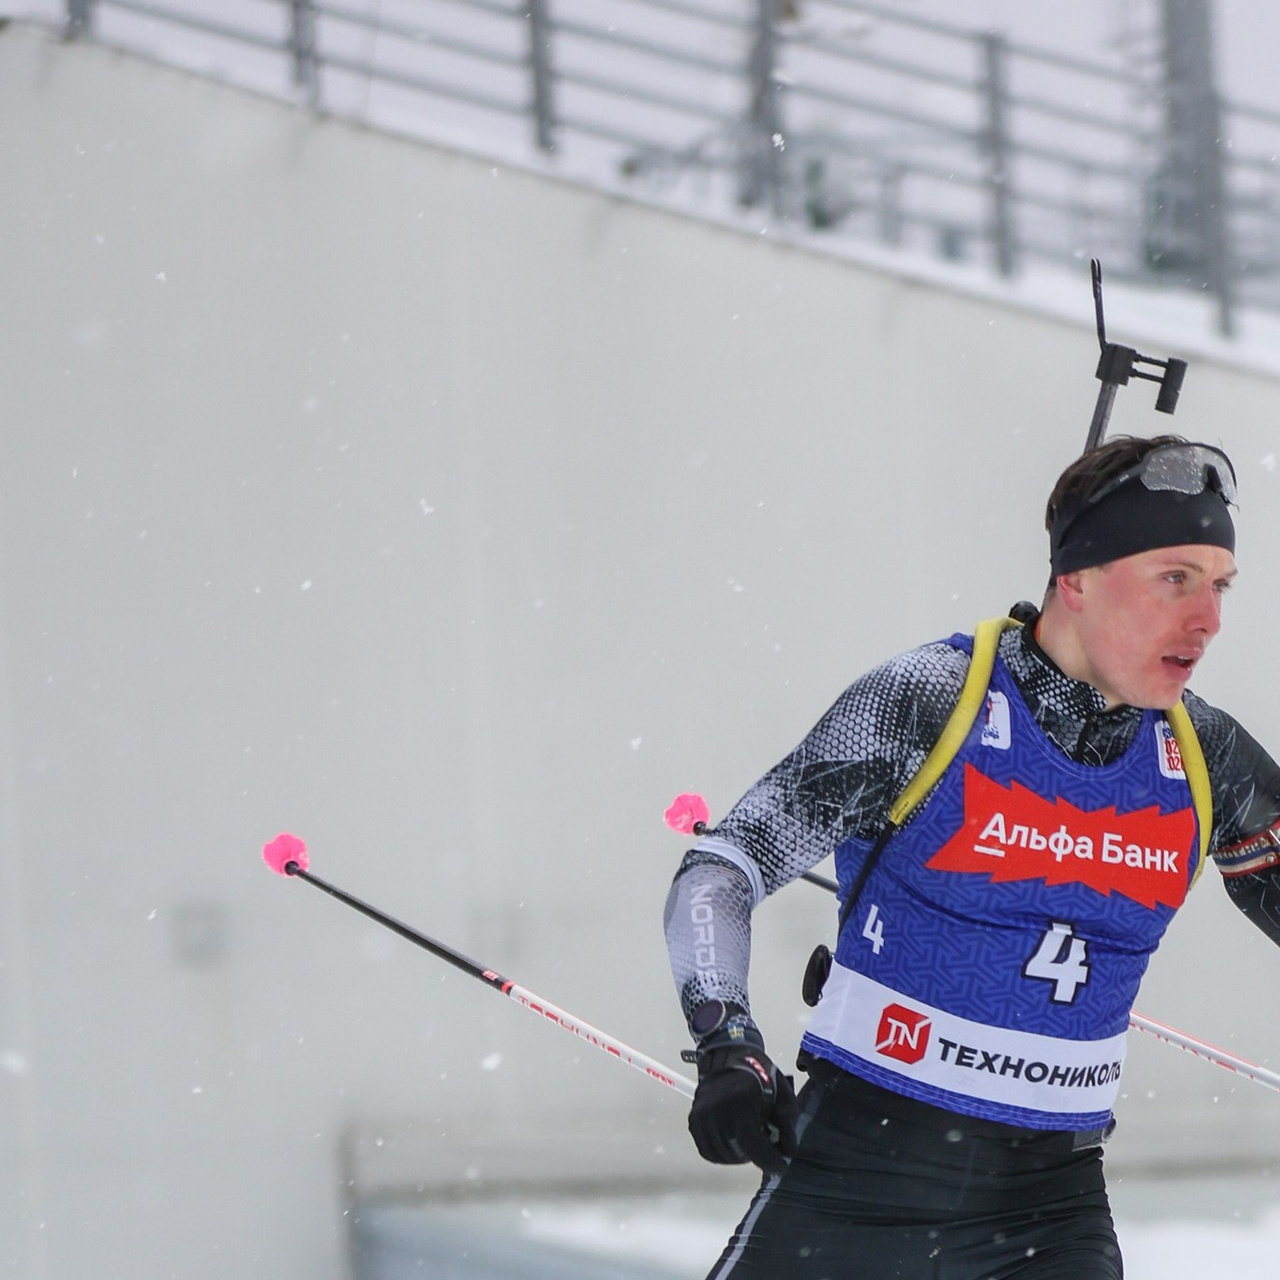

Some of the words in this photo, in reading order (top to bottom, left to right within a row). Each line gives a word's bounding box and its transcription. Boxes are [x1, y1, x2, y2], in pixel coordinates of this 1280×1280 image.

[973, 812, 1094, 862] Альфа
[1102, 832, 1179, 874] Банк
[862, 904, 884, 955] 4
[1022, 920, 1091, 1005] 4
[938, 1037, 1122, 1089] ТЕХНОНИКОЛЬ
